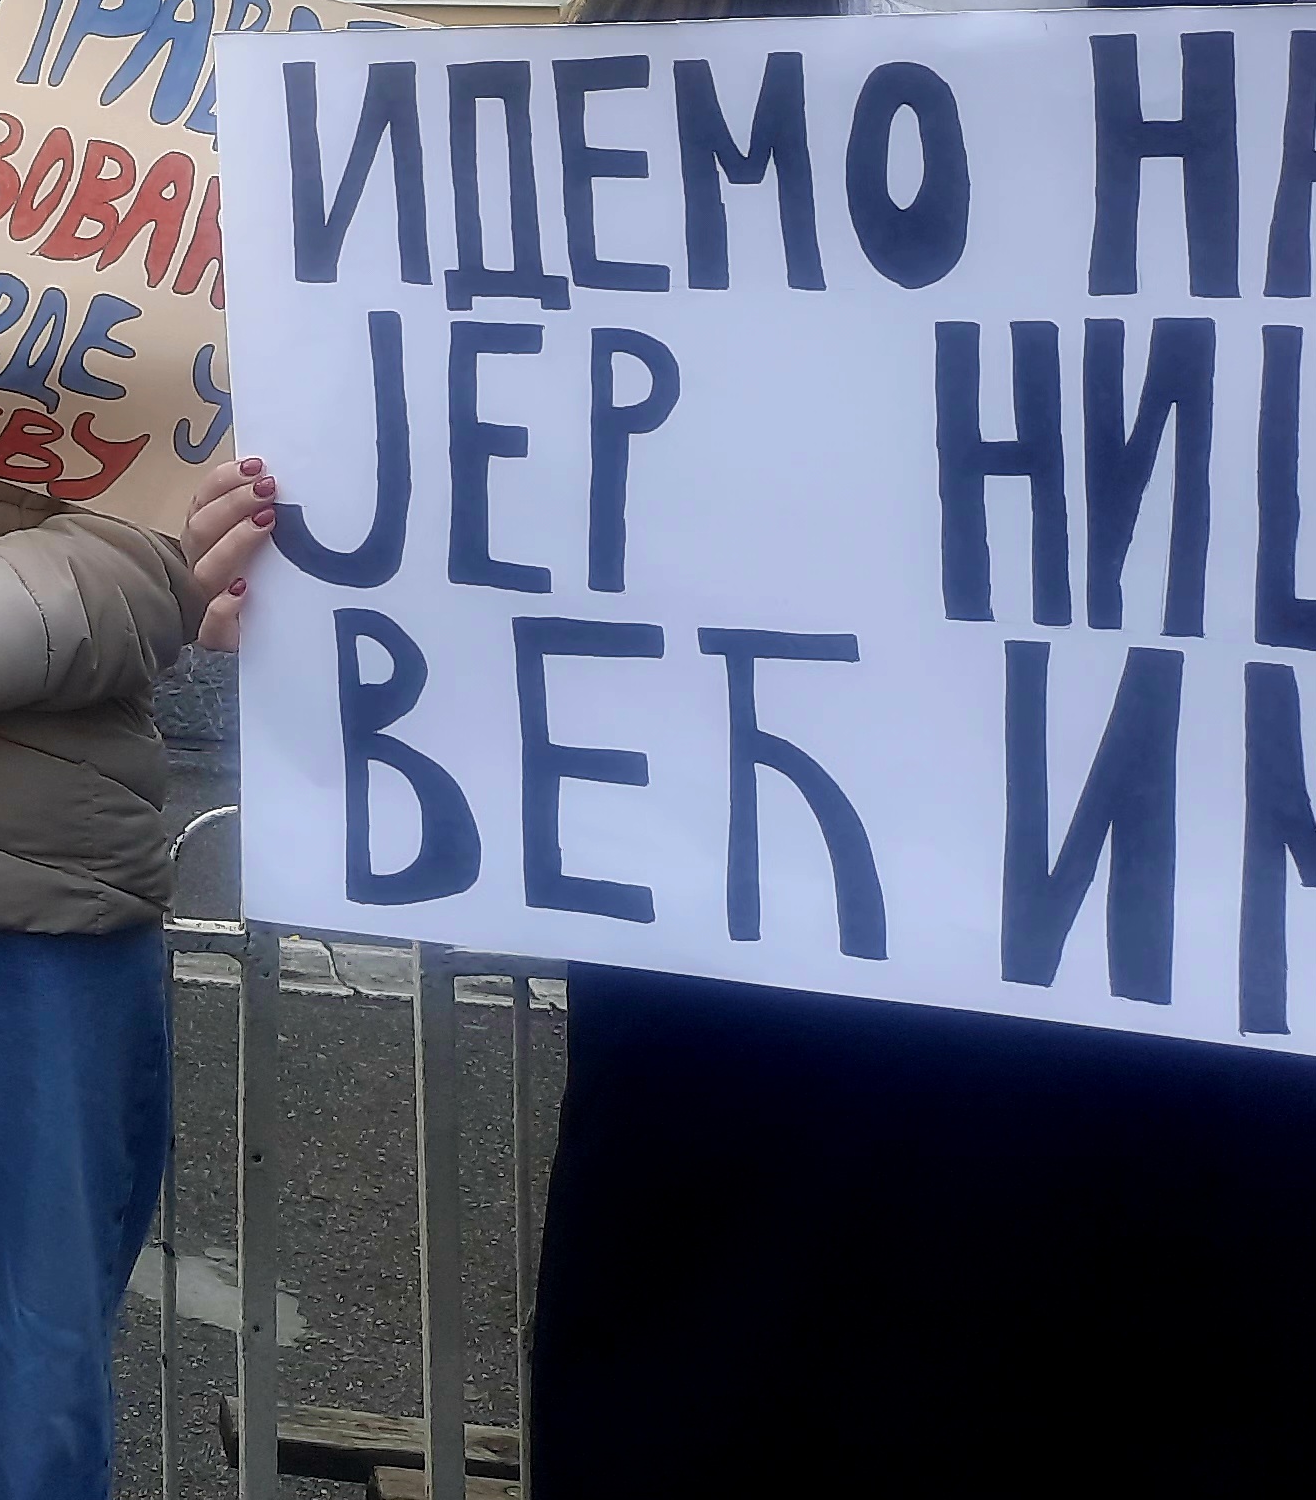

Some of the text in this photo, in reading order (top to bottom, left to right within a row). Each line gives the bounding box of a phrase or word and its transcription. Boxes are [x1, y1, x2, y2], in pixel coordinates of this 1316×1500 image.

[282, 52, 971, 311] ИДЕМО
[271, 311, 681, 593] ЈЕР
[332, 608, 888, 960] ВЕЋ
